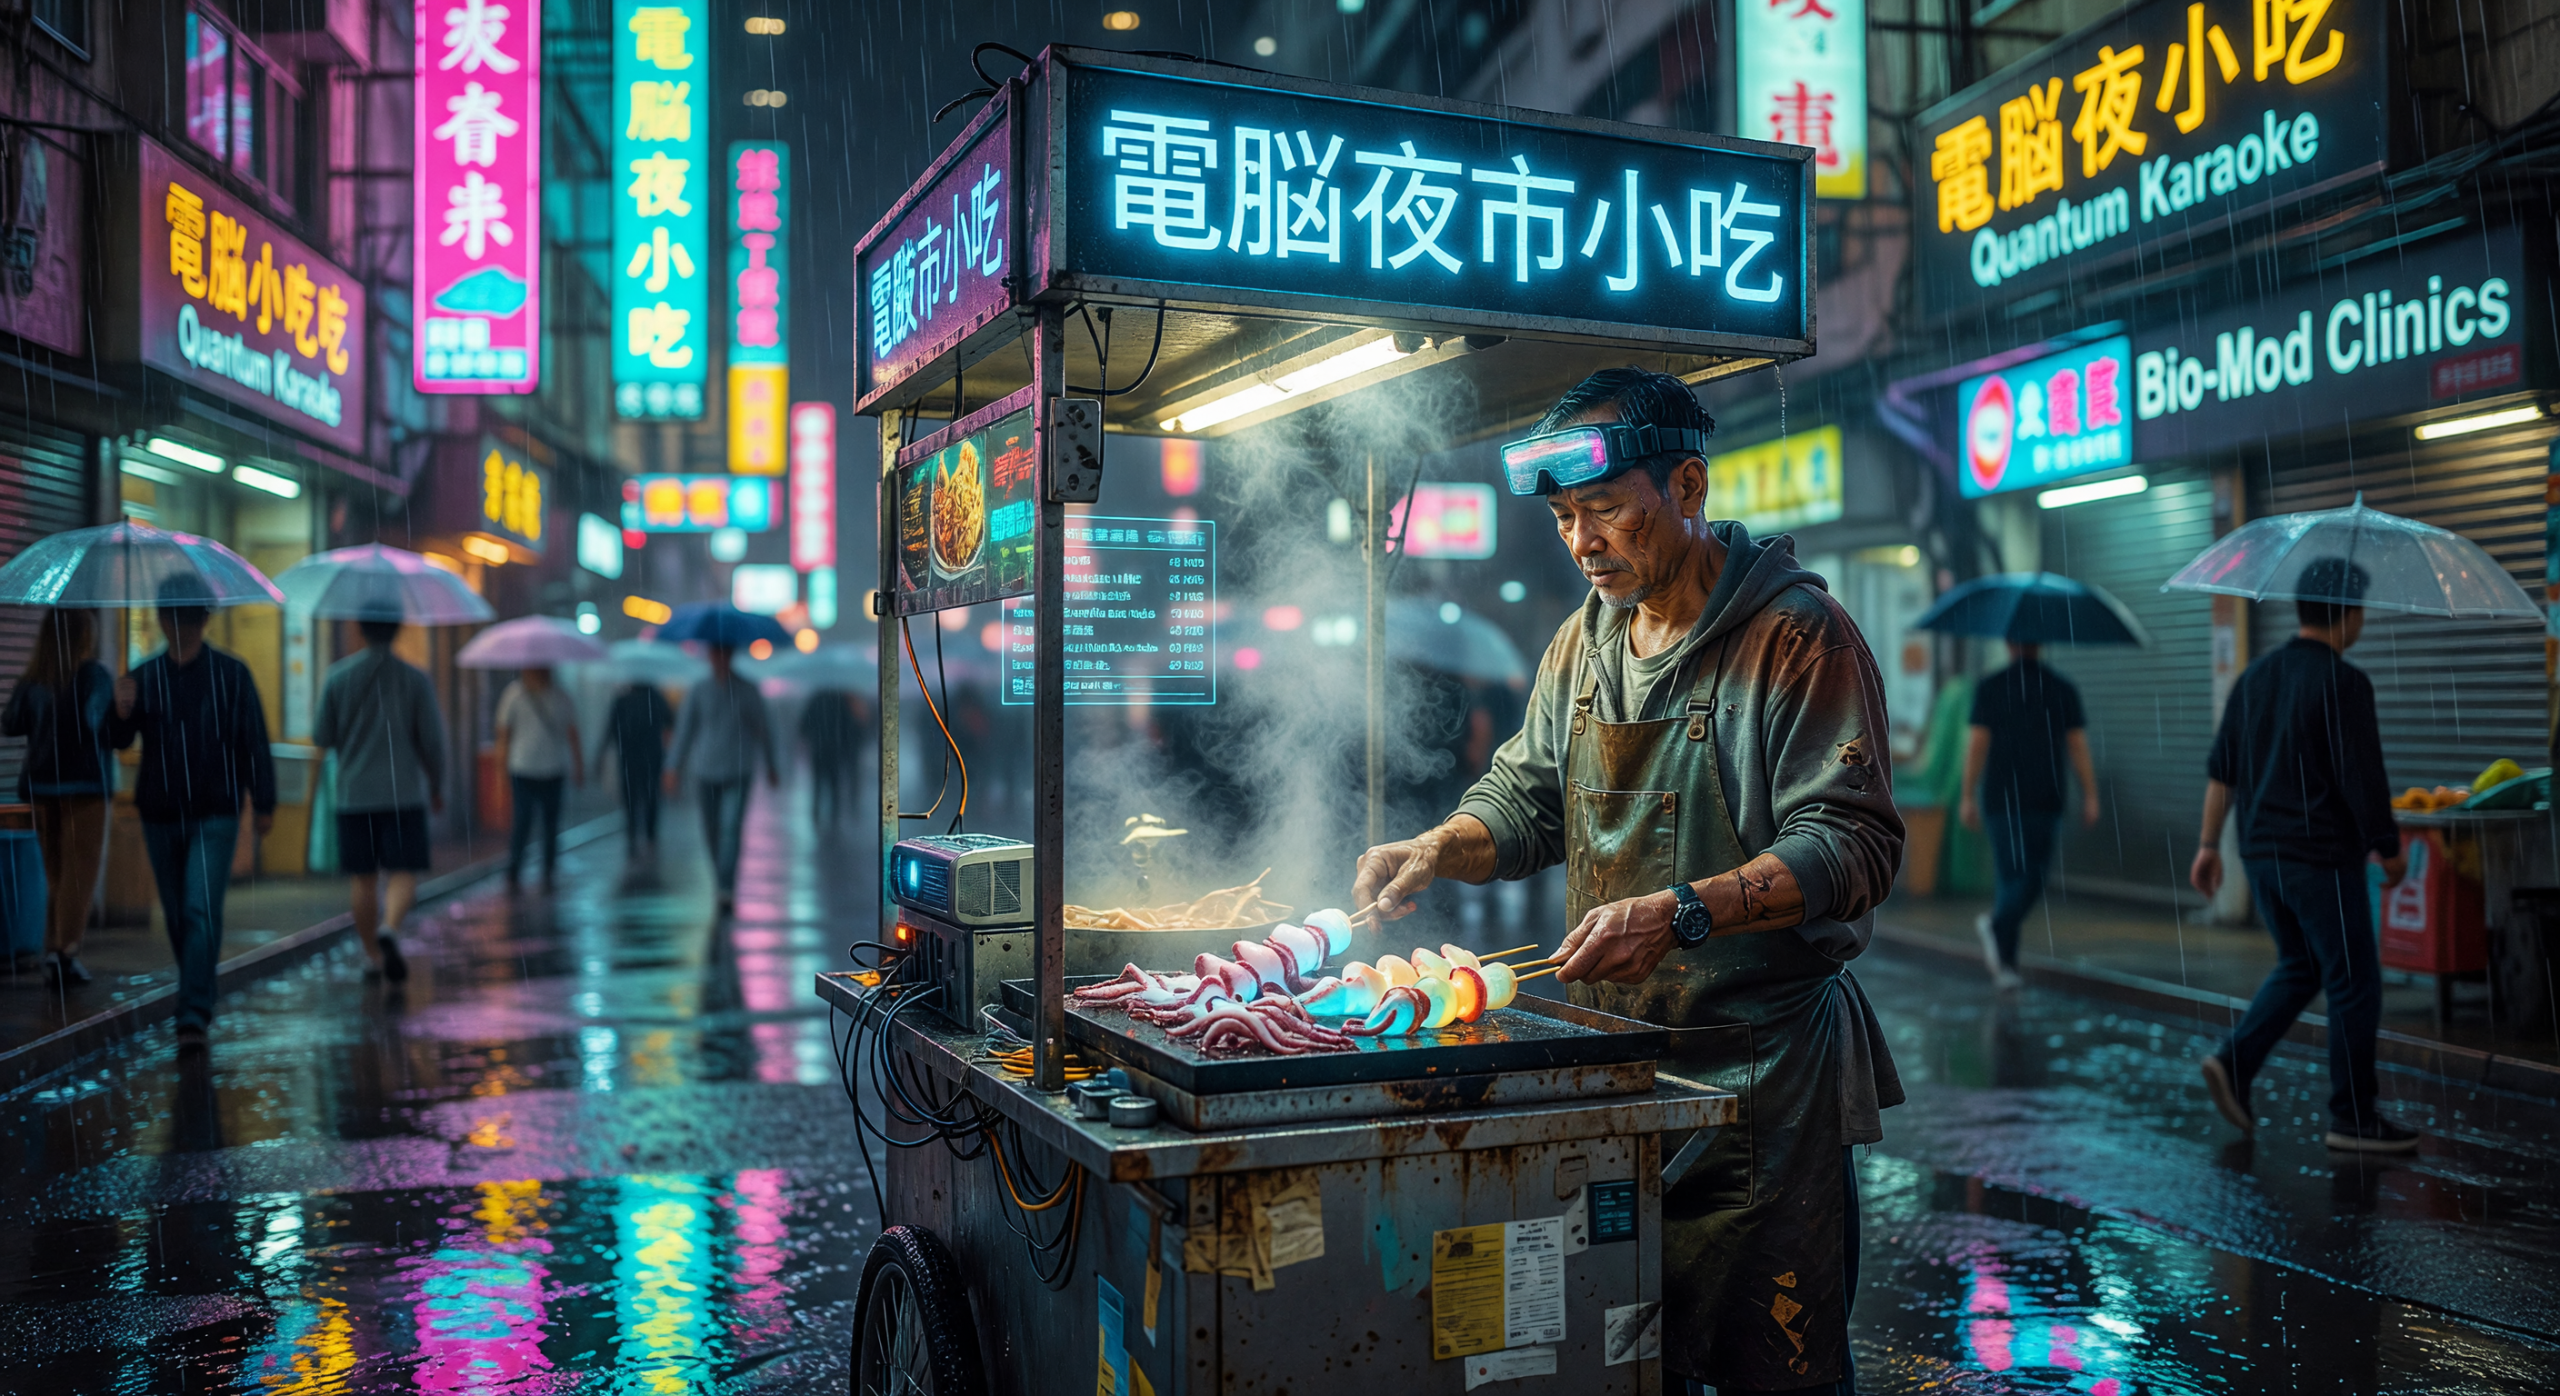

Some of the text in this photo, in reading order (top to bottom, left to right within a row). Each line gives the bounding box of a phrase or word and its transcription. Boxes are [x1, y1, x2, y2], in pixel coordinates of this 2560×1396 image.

[1970, 109, 2319, 287] Quantum Karaoke
[2136, 310, 2314, 420] Bio-Mod
[2326, 275, 2511, 374] Clinics
